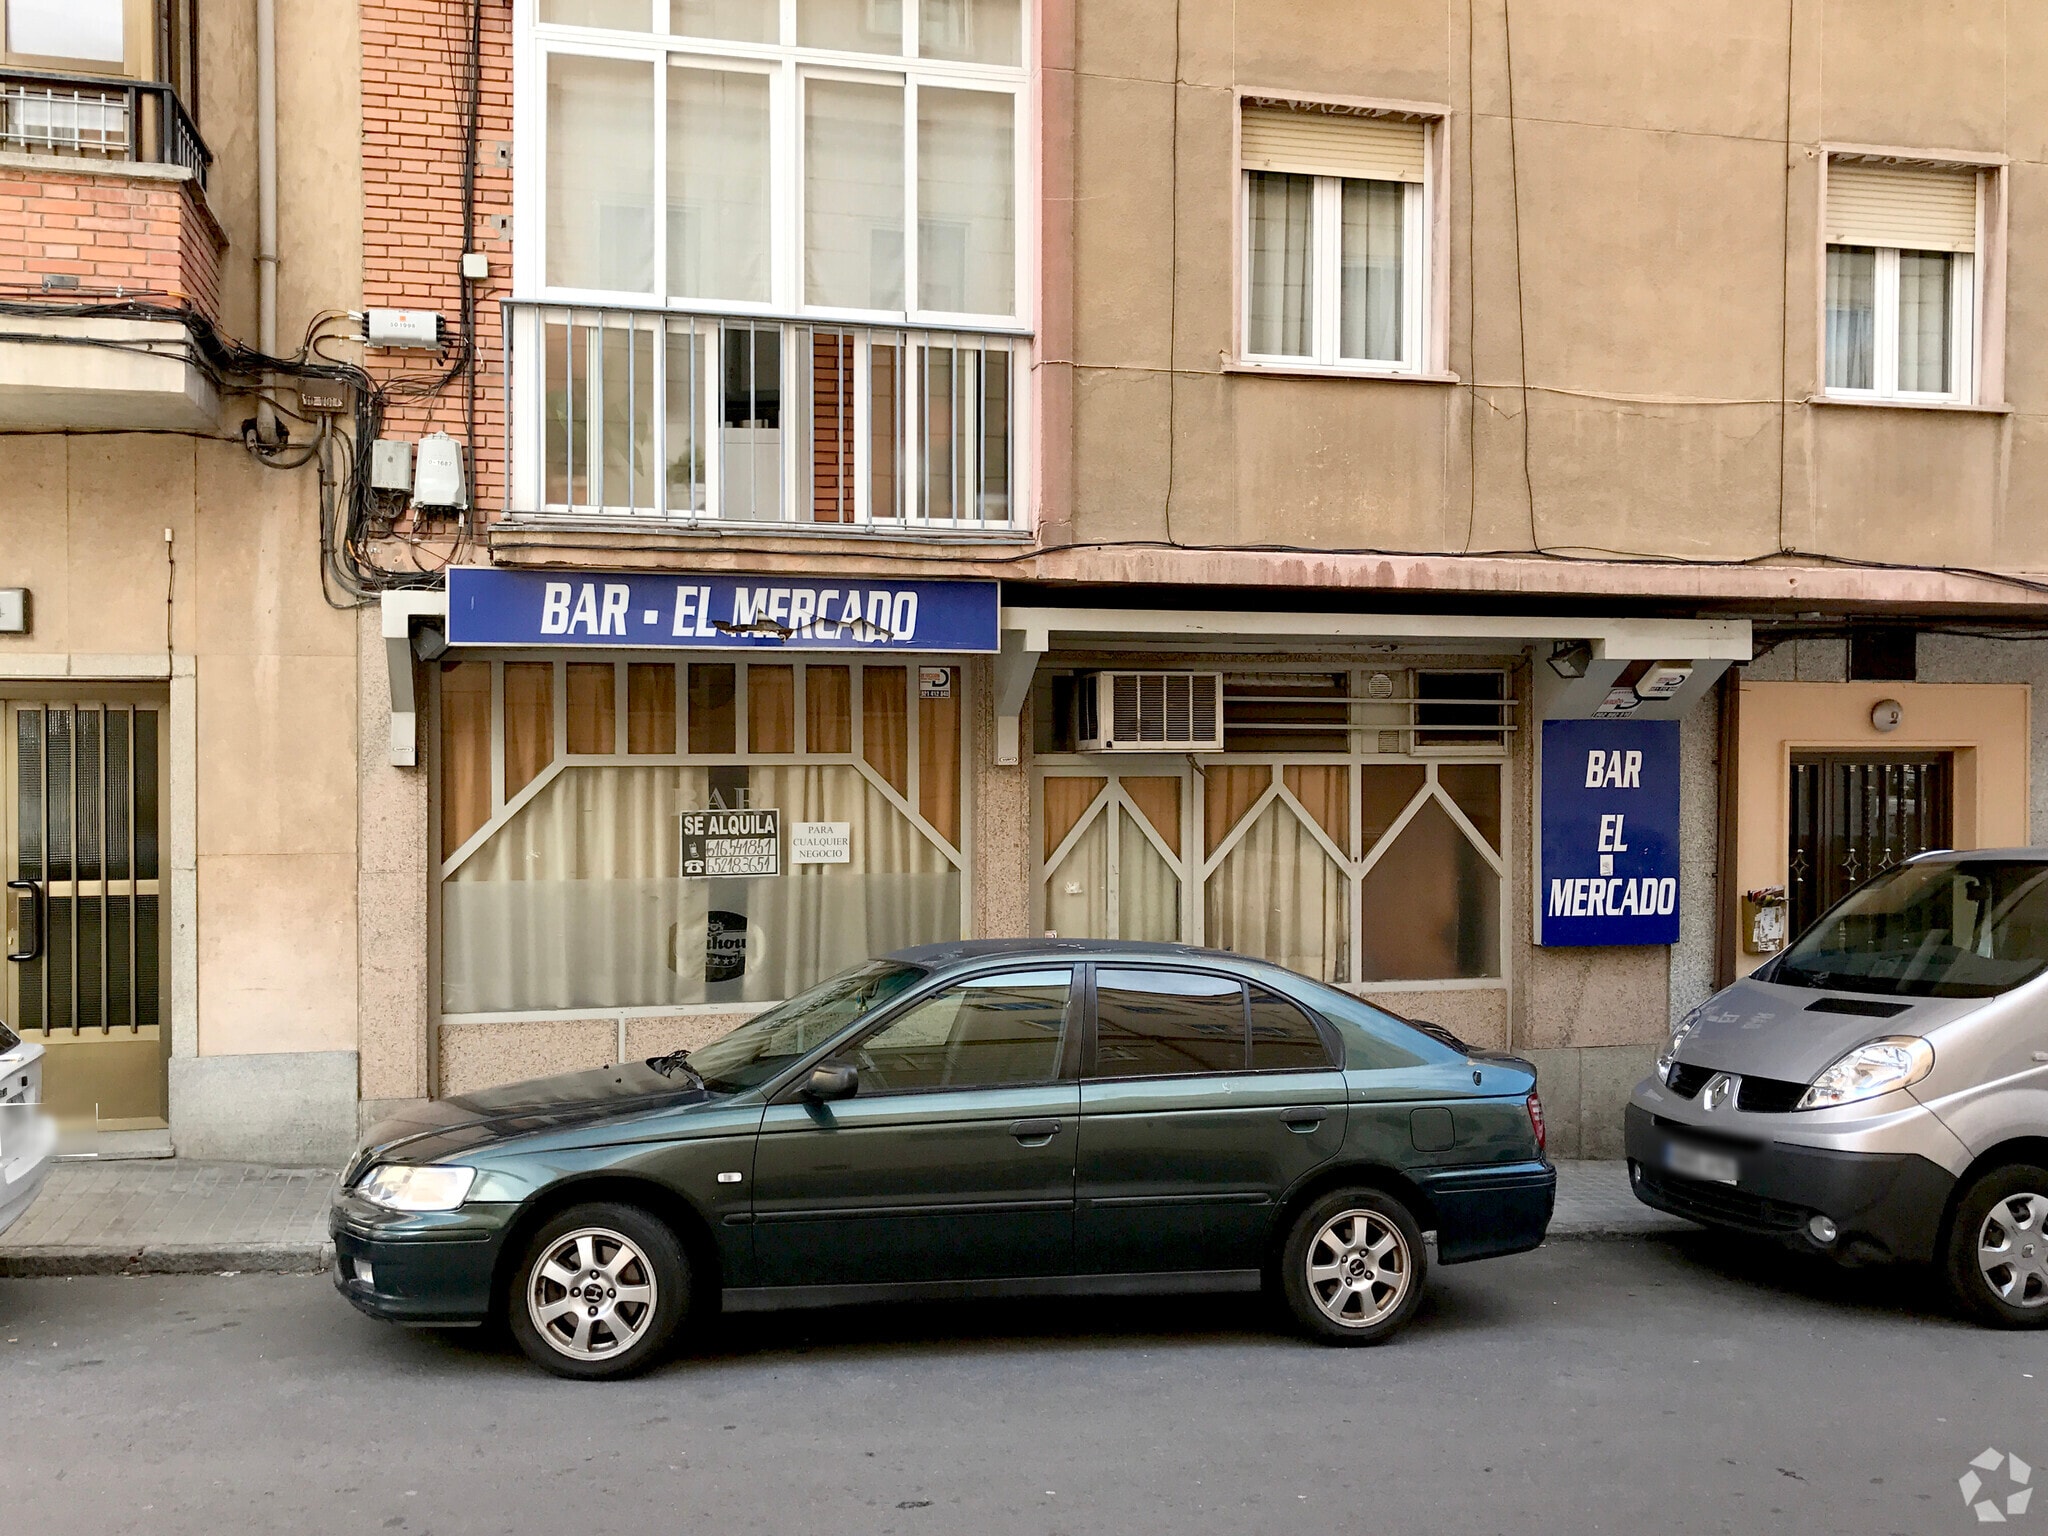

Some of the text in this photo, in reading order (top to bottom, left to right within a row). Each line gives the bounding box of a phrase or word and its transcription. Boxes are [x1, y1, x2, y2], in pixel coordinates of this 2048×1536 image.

[540, 581, 631, 636] BAR
[671, 584, 719, 638] EL
[730, 587, 919, 644] MERCADO
[1889, 711, 1899, 724] 2
[1585, 749, 1643, 788] BAR
[684, 814, 775, 836] SE ALQUILA
[808, 826, 834, 834] PARA
[1597, 814, 1628, 852] EL
[792, 837, 849, 847] CUALQUIER
[799, 849, 843, 858] NEGOCIO
[1548, 877, 1677, 917] MERCADO
